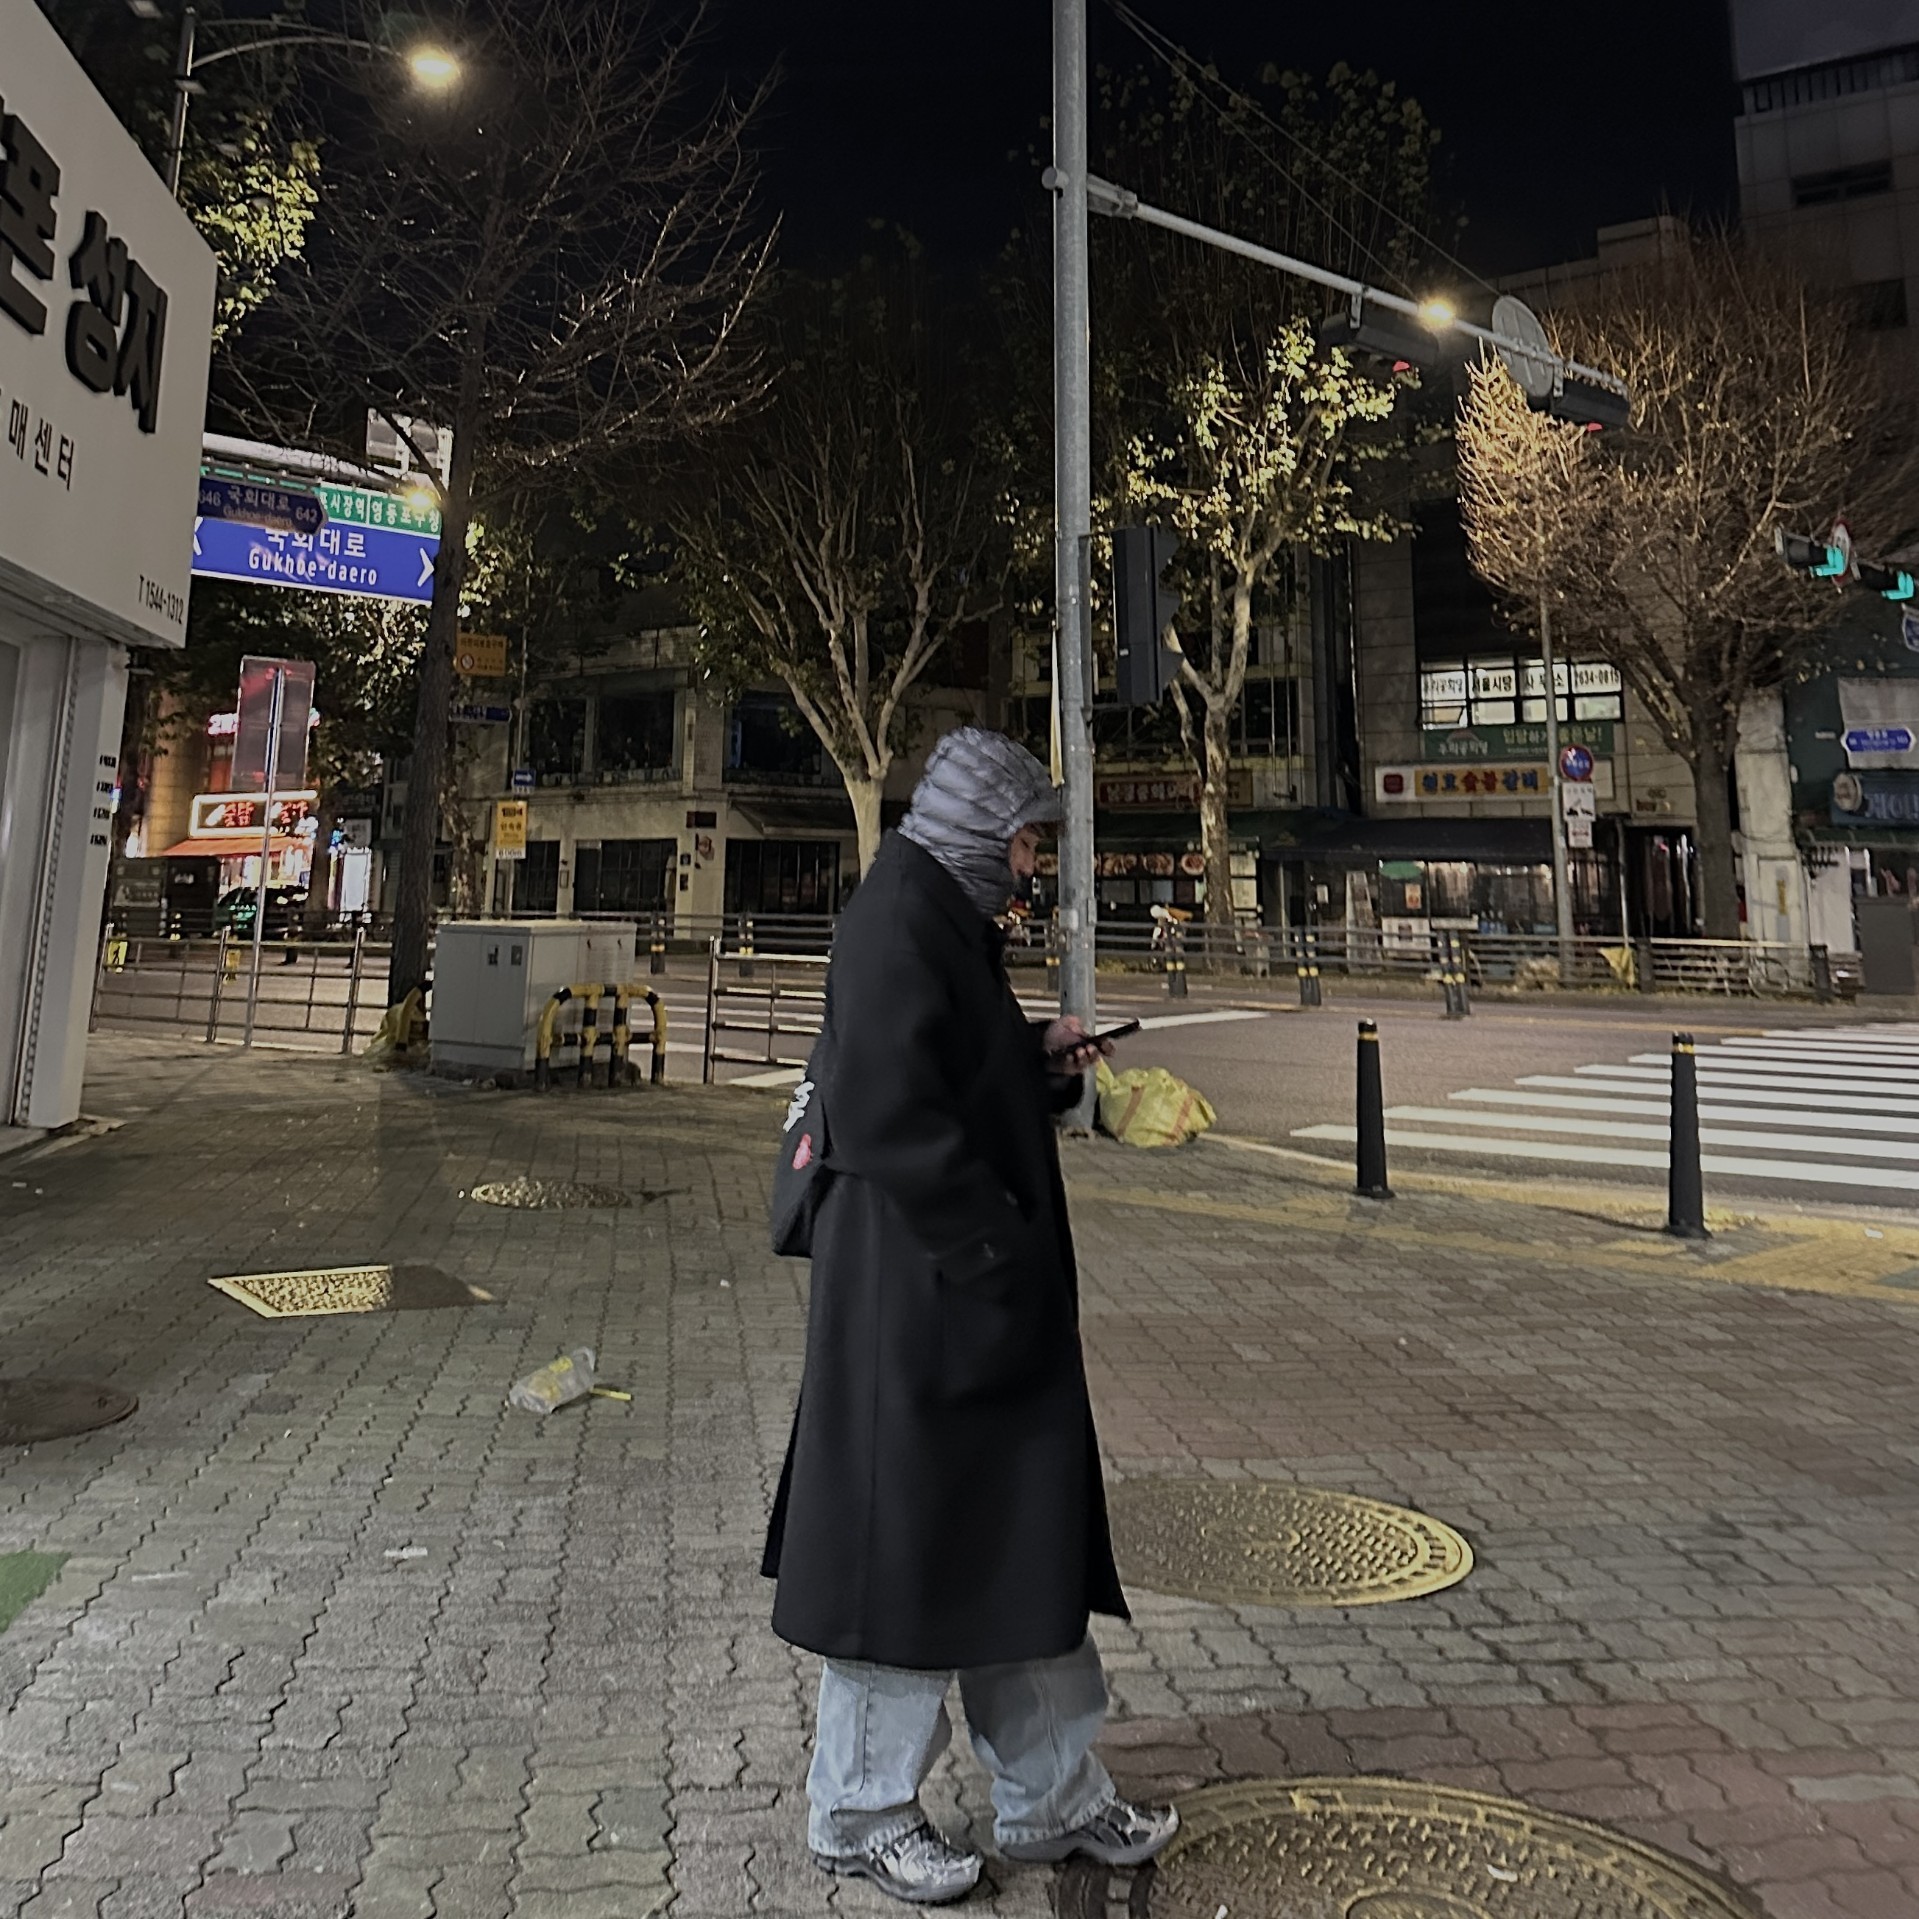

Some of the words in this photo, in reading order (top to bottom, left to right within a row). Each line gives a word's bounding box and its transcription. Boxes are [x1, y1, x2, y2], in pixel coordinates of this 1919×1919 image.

[66, 210, 169, 434] 성지
[227, 484, 291, 512] 국회대로
[295, 506, 318, 523] 642
[249, 547, 377, 586] Gukhoe-daero
[146, 580, 184, 625] 1544-1312
